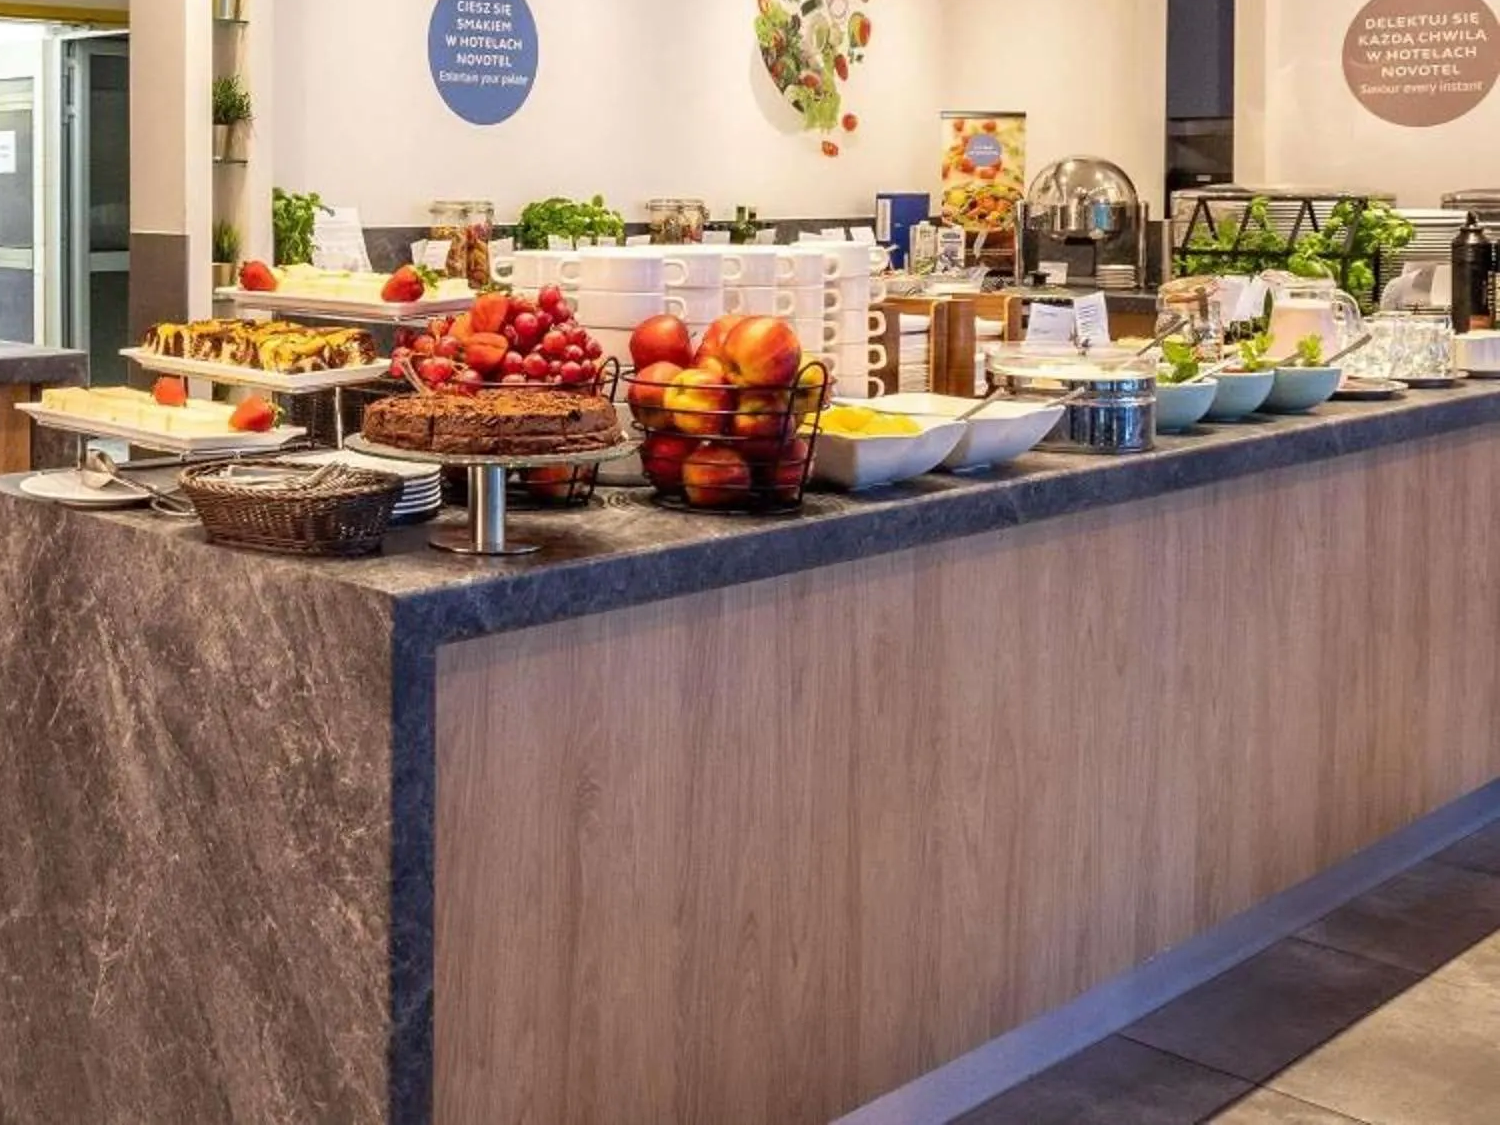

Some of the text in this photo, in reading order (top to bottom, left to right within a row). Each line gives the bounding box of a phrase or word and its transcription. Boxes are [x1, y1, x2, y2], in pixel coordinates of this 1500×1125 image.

[457, 0, 491, 14] CIESZ
[456, 18, 512, 32] SMAKIEM
[1364, 14, 1448, 30] DELEKTUJ
[445, 34, 522, 51] W HOTELACH
[456, 53, 513, 68] NOVOTEL
[1365, 46, 1477, 62] W HOTELACH
[1380, 63, 1462, 78] NOVOTEL
[481, 74, 499, 86] your
[1403, 82, 1437, 95] every
[1439, 80, 1482, 92] instant
